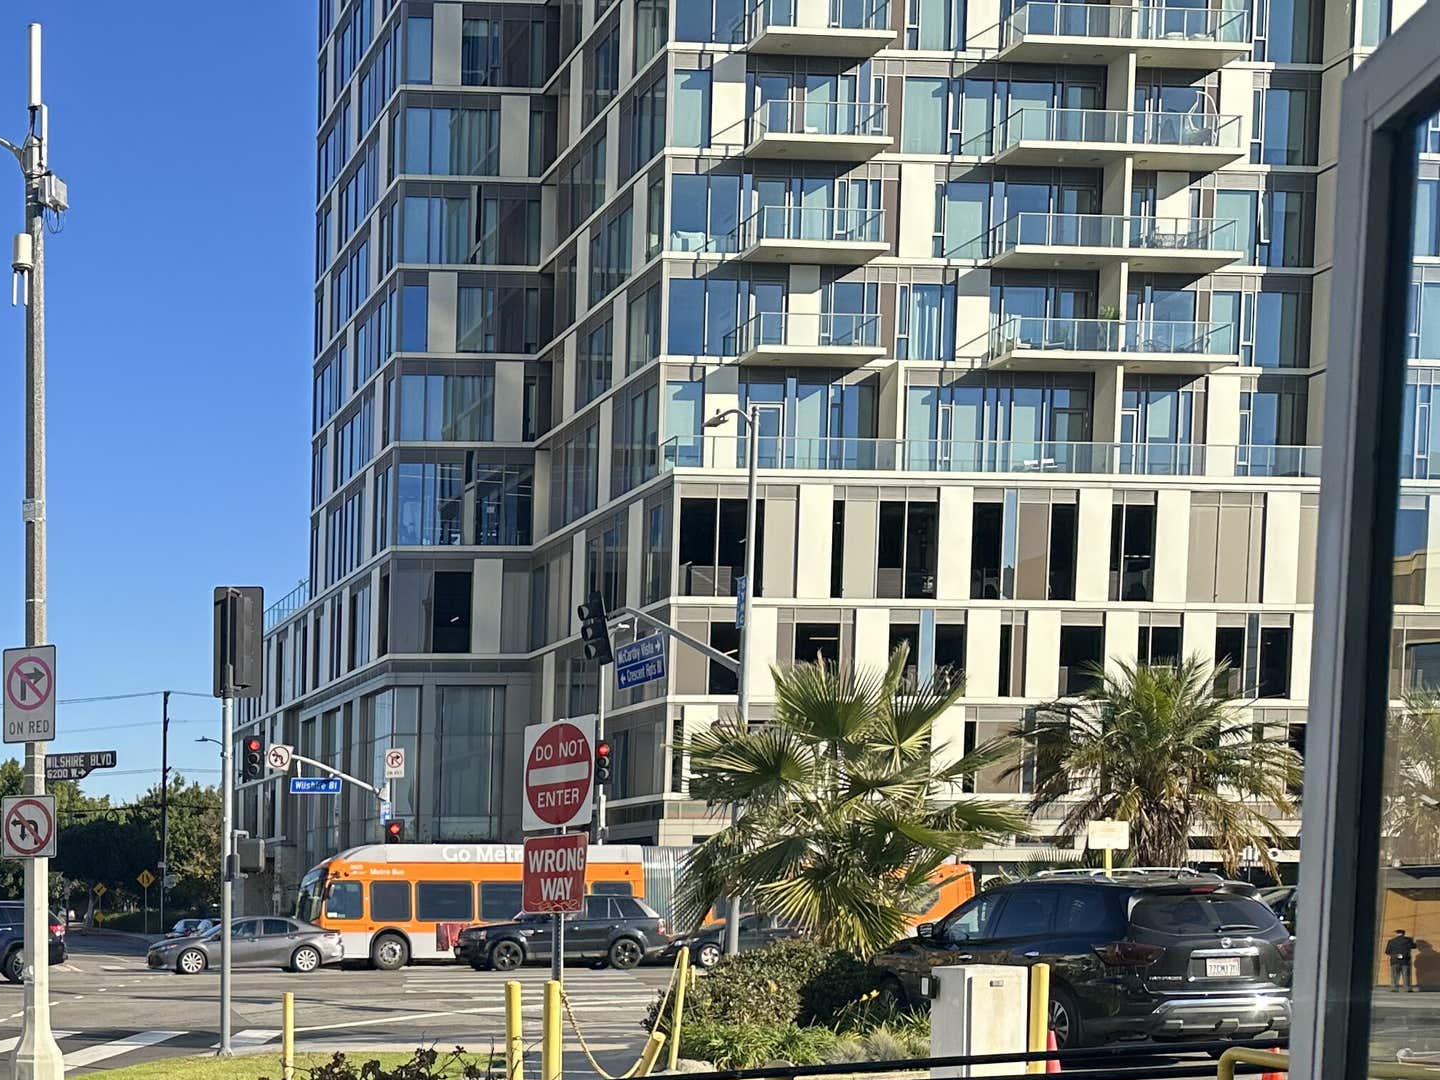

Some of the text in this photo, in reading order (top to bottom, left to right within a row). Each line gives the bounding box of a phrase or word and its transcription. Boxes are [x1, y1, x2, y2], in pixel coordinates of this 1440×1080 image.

[9, 720, 49, 735] ON RED
[535, 739, 585, 761] DO NOT
[46, 754, 85, 768] WILSHIRE
[46, 768, 69, 779] 6200
[295, 782, 326, 790] Wilshire
[537, 787, 580, 808] ENTER
[441, 845, 524, 863] Go Metr
[528, 847, 585, 873] WRONG
[540, 877, 574, 901] WAY
